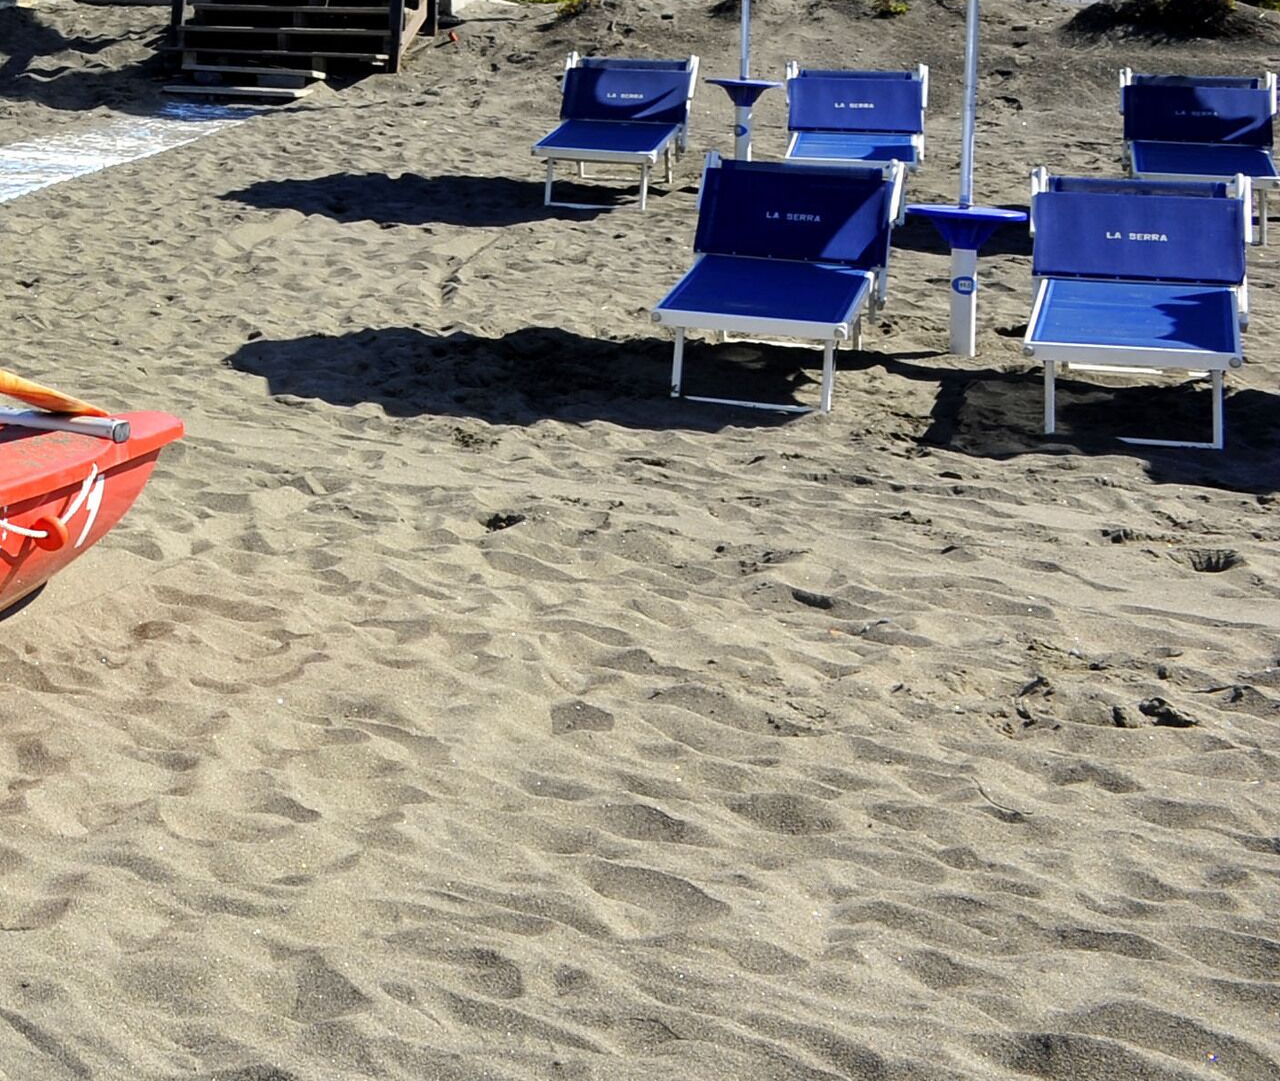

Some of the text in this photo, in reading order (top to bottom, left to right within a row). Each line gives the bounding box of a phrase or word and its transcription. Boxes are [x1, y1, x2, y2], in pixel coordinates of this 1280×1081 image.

[766, 210, 821, 222] LA SERRA
[1106, 231, 1168, 242] LA SERRA
[75, 473, 106, 550] 1
